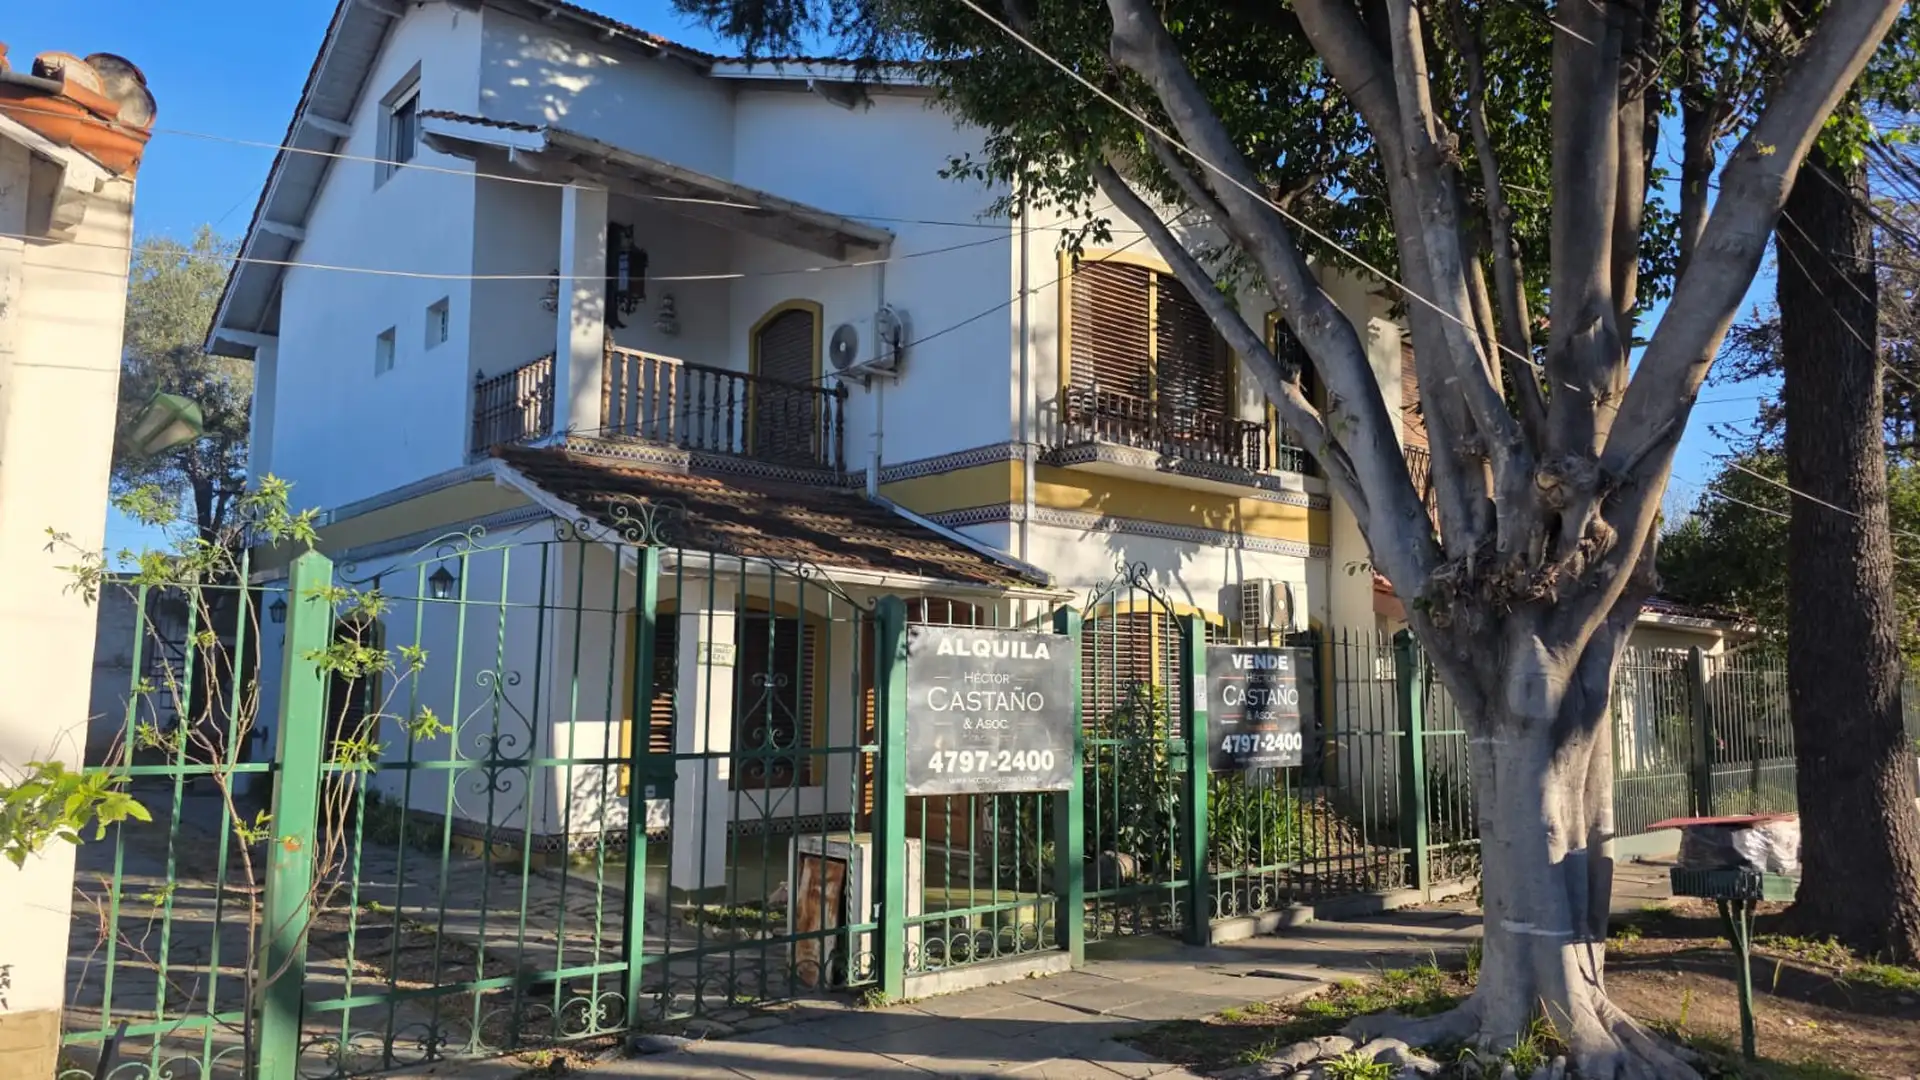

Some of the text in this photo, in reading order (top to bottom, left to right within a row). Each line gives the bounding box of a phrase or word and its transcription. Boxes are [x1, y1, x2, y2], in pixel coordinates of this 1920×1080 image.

[936, 637, 1051, 660] ALQUILA
[1231, 653, 1289, 670] VENDE
[963, 670, 1010, 684] HÉCTOR
[927, 686, 1044, 711] CASTAÑO
[1222, 684, 1299, 706] CASTAÑO
[963, 717, 973, 730] &
[1221, 731, 1303, 753] 4797-2400
[927, 749, 1055, 773] 4797-2400
